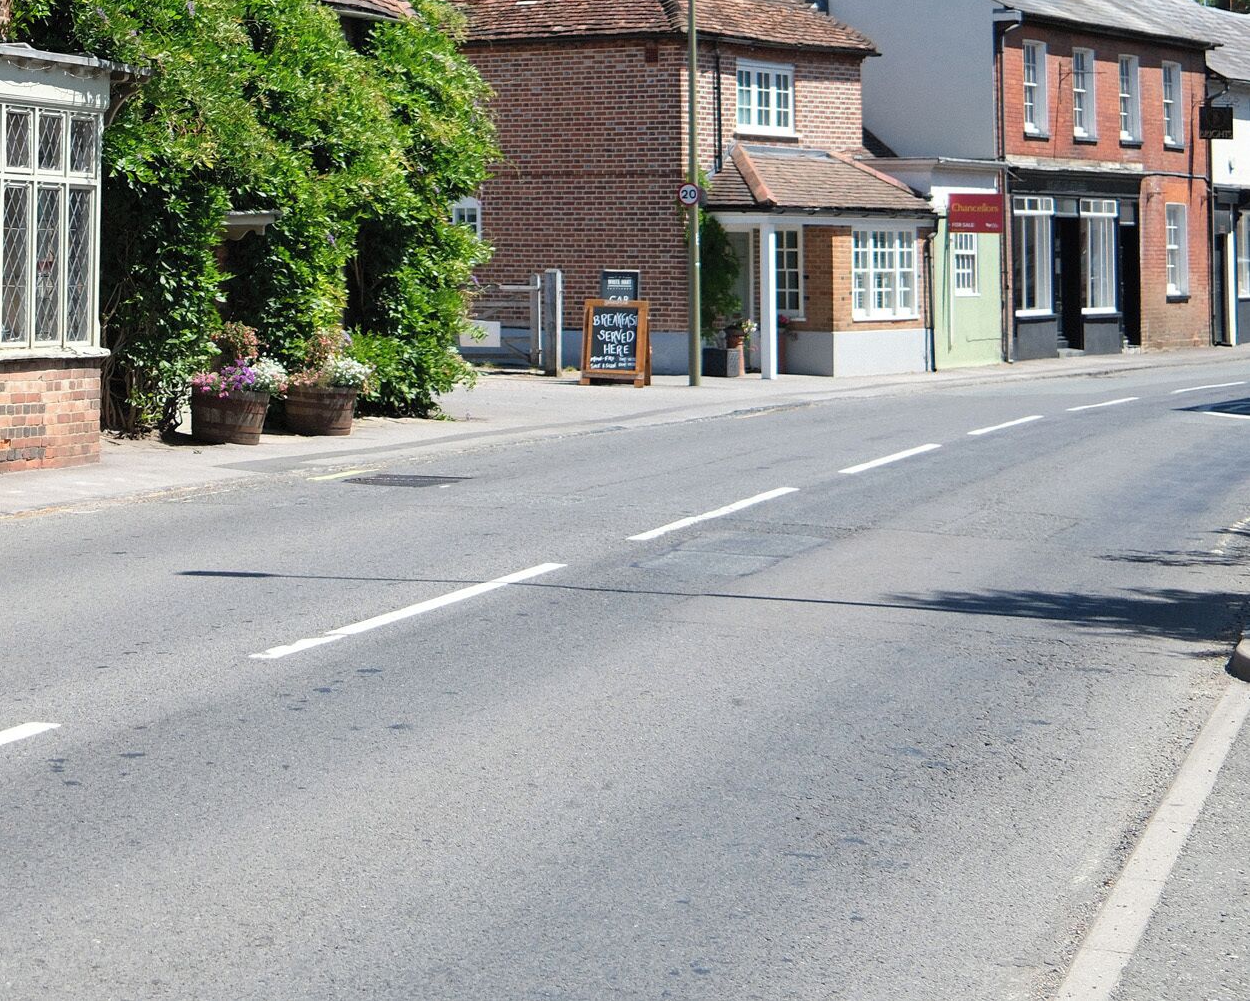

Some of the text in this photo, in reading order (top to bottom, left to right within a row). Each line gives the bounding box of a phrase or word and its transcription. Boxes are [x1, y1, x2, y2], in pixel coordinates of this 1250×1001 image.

[681, 189, 697, 199] 20
[951, 202, 998, 212] Chancellors
[593, 312, 638, 328] BREAKFAST
[597, 329, 635, 344] SERVED
[603, 344, 630, 357] HERE
